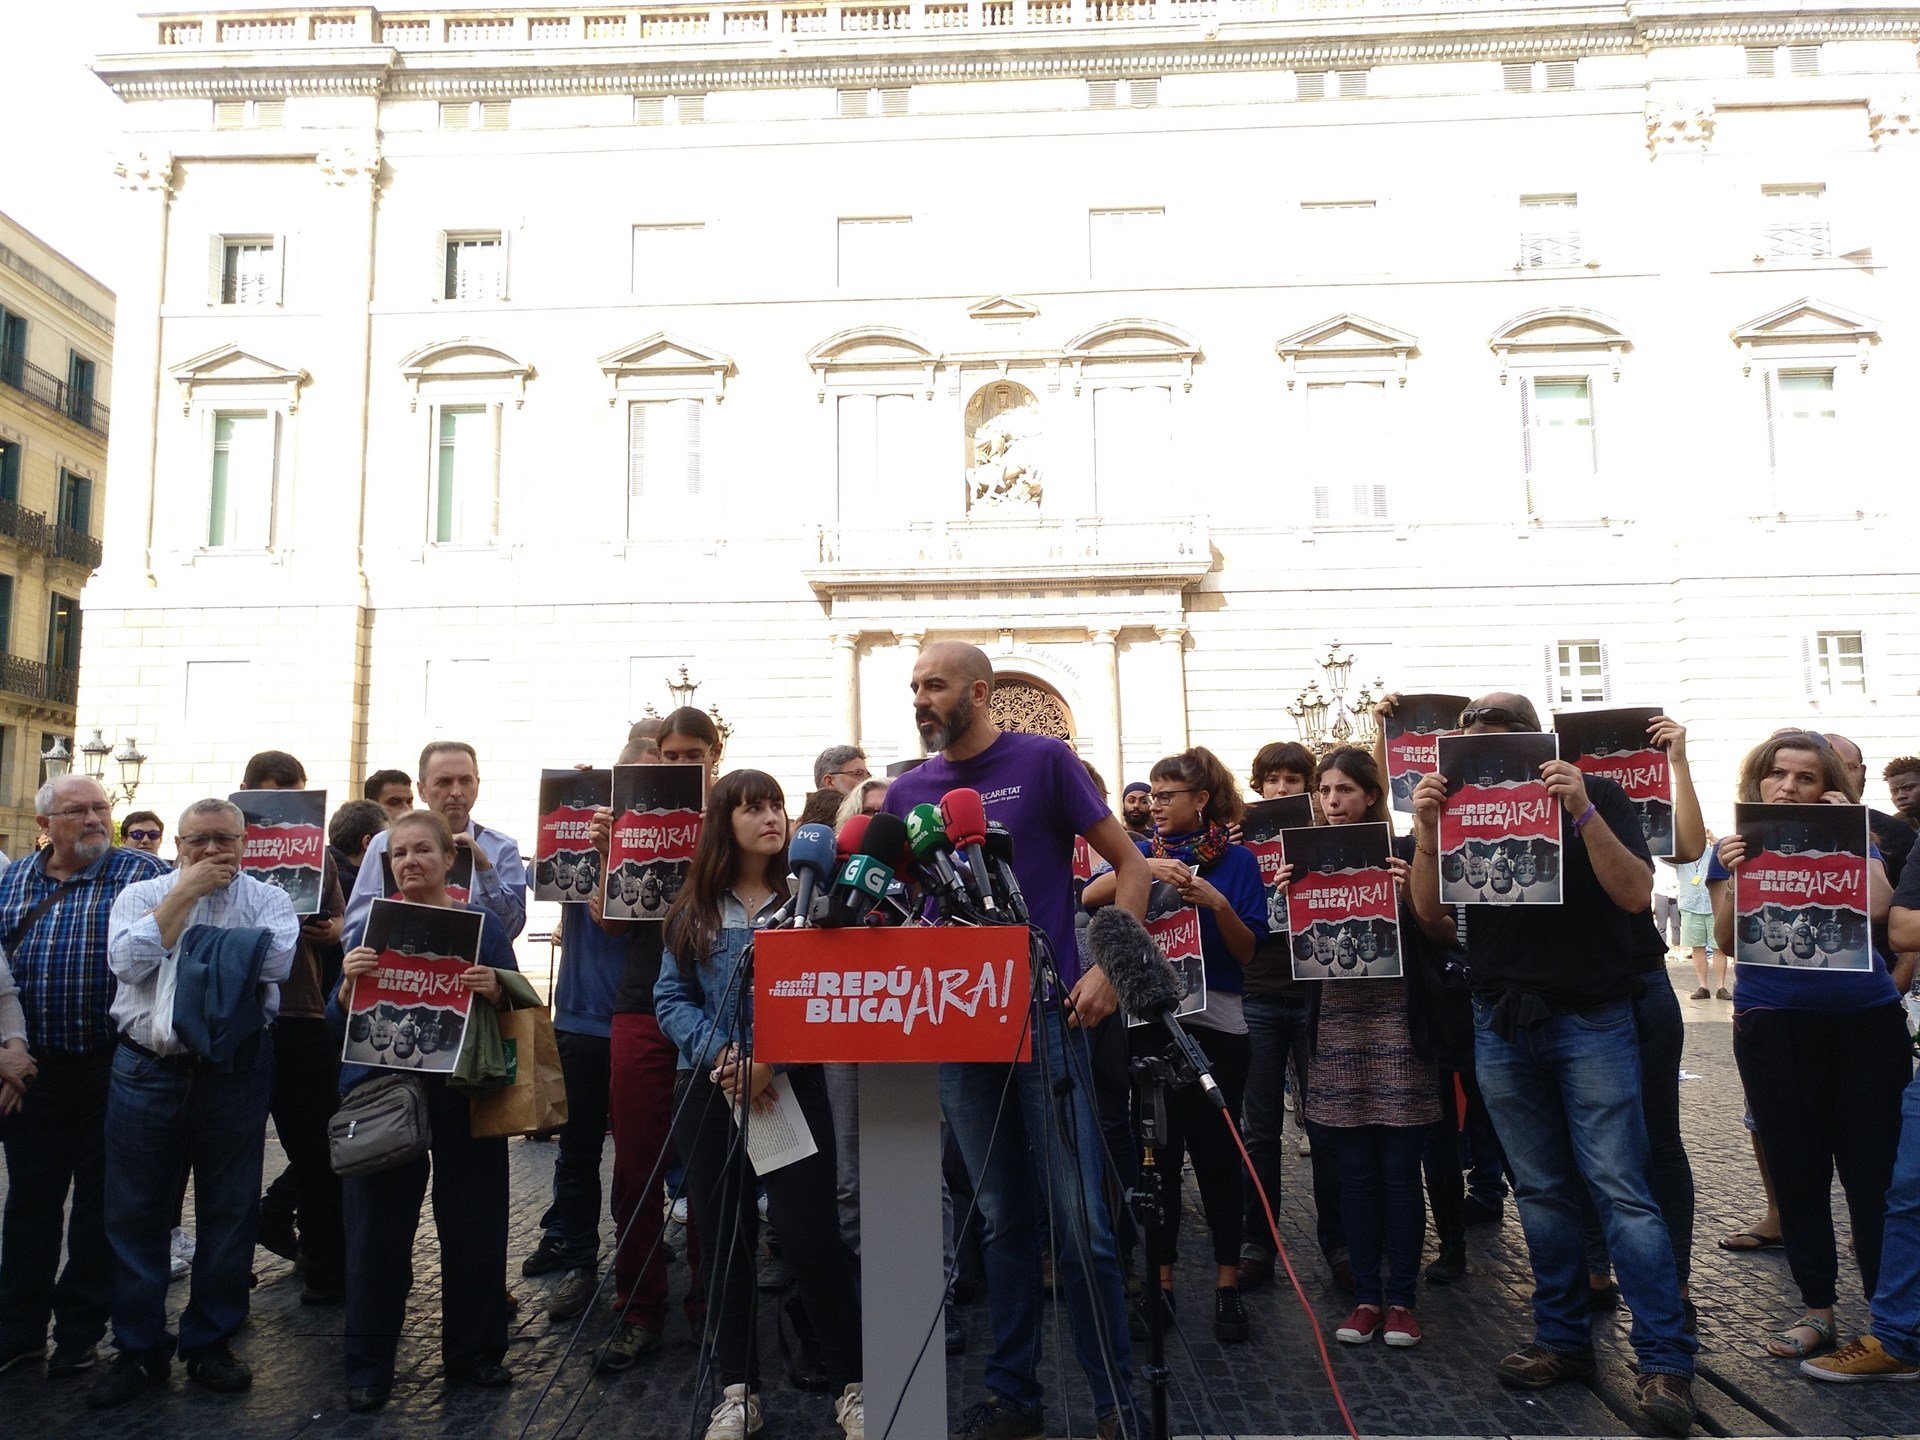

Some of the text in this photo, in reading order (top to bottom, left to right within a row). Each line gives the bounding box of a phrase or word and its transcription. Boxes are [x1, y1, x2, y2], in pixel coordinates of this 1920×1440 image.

[1403, 753, 1436, 764] BLICA
[1621, 763, 1664, 790] ARA!
[981, 786, 1021, 801] ECARIETAT
[1466, 800, 1507, 815] REPÚ
[1503, 797, 1552, 830] ARA!
[1461, 814, 1503, 826] BLICA
[555, 830, 590, 840] BLICA
[625, 826, 658, 839] REPÚ
[653, 823, 698, 853] ARA!
[797, 830, 820, 842] tve
[247, 837, 281, 848] REPÚ
[277, 836, 319, 861] ARA!
[621, 838, 655, 849] BLICA
[1257, 851, 1280, 864] EPÚ
[844, 859, 861, 881] G
[1260, 862, 1279, 872] ICA
[864, 867, 886, 893] G
[1765, 869, 1811, 882] REPÚ
[1760, 880, 1807, 893] BLICA
[1805, 869, 1860, 898] ARA!
[1312, 886, 1348, 899] REPÚ
[1345, 881, 1388, 912] ARA!
[1308, 898, 1347, 909] BLICA
[1166, 920, 1194, 955] ARA!
[384, 968, 425, 982] REPÚ
[801, 972, 816, 981] PA
[817, 965, 912, 997] REPÚ
[377, 978, 420, 993] BLICA
[775, 980, 815, 989] SOSTRE
[768, 988, 814, 997] TREBALL
[903, 959, 1014, 1035] ARA!
[805, 998, 904, 1023] BLICA
